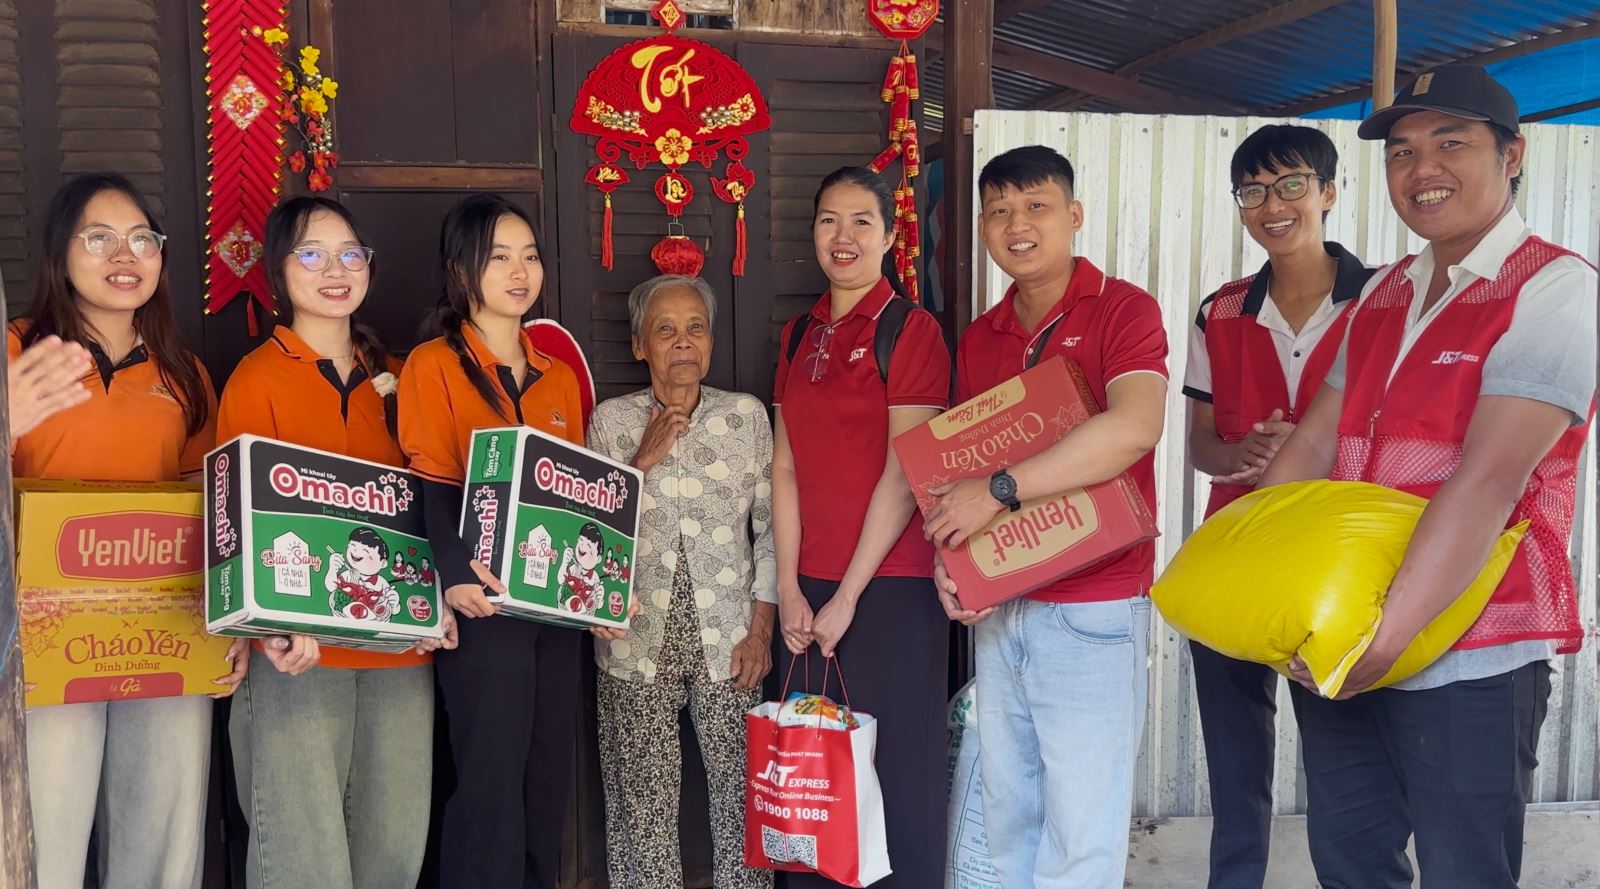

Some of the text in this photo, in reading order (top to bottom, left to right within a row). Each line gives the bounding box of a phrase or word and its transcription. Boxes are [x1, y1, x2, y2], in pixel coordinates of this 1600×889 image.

[849, 348, 867, 362] J&T
[941, 412, 1044, 473] Cháo Yến
[215, 453, 230, 547] Omachi
[270, 463, 396, 516] Omachi
[535, 457, 616, 513] Omachi
[78, 527, 188, 567] YenViet
[479, 500, 498, 572] machi
[64, 628, 191, 664] Cháo Yến
[124, 659, 161, 671] Dưỡng
[756, 760, 831, 789] J&T EXPRESS
[763, 801, 829, 821] 1900 1088
[779, 792, 803, 800] Online
